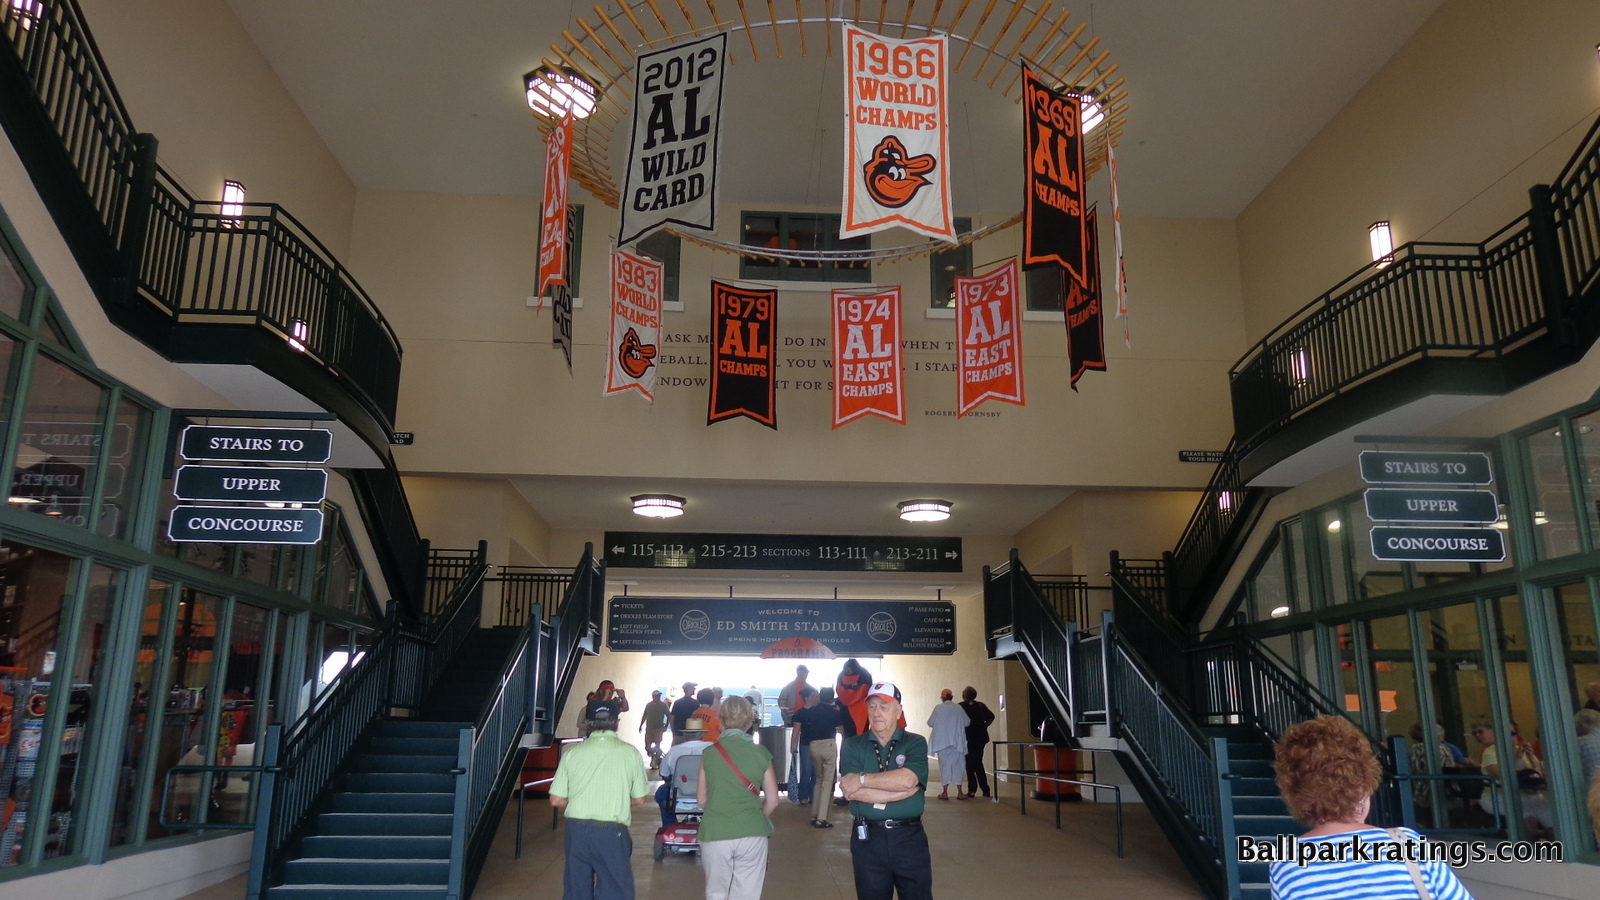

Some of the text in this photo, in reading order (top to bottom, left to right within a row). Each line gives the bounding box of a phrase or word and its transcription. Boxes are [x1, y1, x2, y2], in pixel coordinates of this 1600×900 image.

[643, 47, 717, 94] 2012
[856, 41, 936, 79] 1966
[856, 76, 937, 108] WORLD
[643, 86, 711, 151] AL
[856, 104, 937, 131] CHAMPS
[641, 141, 707, 183] WILD
[1033, 126, 1077, 192] AL
[633, 173, 705, 212] CARD
[617, 255, 657, 293] 1983
[616, 282, 657, 312] WORLD
[961, 273, 1010, 306] 1973
[616, 303, 659, 329] CHAMPS
[719, 293, 769, 321] 1979
[840, 299, 891, 323] 1974
[965, 299, 1011, 346] AL
[664, 333, 691, 343] ASK
[697, 334, 709, 344] M
[785, 337, 804, 347] DO
[810, 337, 826, 347] IN
[720, 319, 768, 359] AL
[842, 323, 893, 360] AL
[660, 355, 708, 365] EBALL.
[787, 359, 816, 368] YOU
[925, 363, 957, 371] STAR
[965, 339, 1012, 367] EAST
[719, 359, 768, 378] CHAMPS
[842, 361, 893, 383] EAST
[965, 363, 1013, 385] CHAMPS
[795, 381, 822, 390] FOR
[842, 382, 894, 397] CHAMPS
[209, 437, 304, 452] STAIRS TO
[1384, 461, 1467, 475] STAIRS TO
[222, 476, 281, 492] UPPER
[1405, 498, 1459, 513] UPPER
[187, 517, 304, 532] CONCOURSE
[631, 543, 939, 560] 115-113 215-213 SECTIONS 113-111 213-211
[1386, 536, 1489, 551] CONCOURSE
[682, 619, 708, 631] ORIOLES
[717, 620, 862, 632] ED SMITH STADIUM
[869, 621, 894, 633] ORIOLES
[771, 648, 826, 658] PROGRAMS
